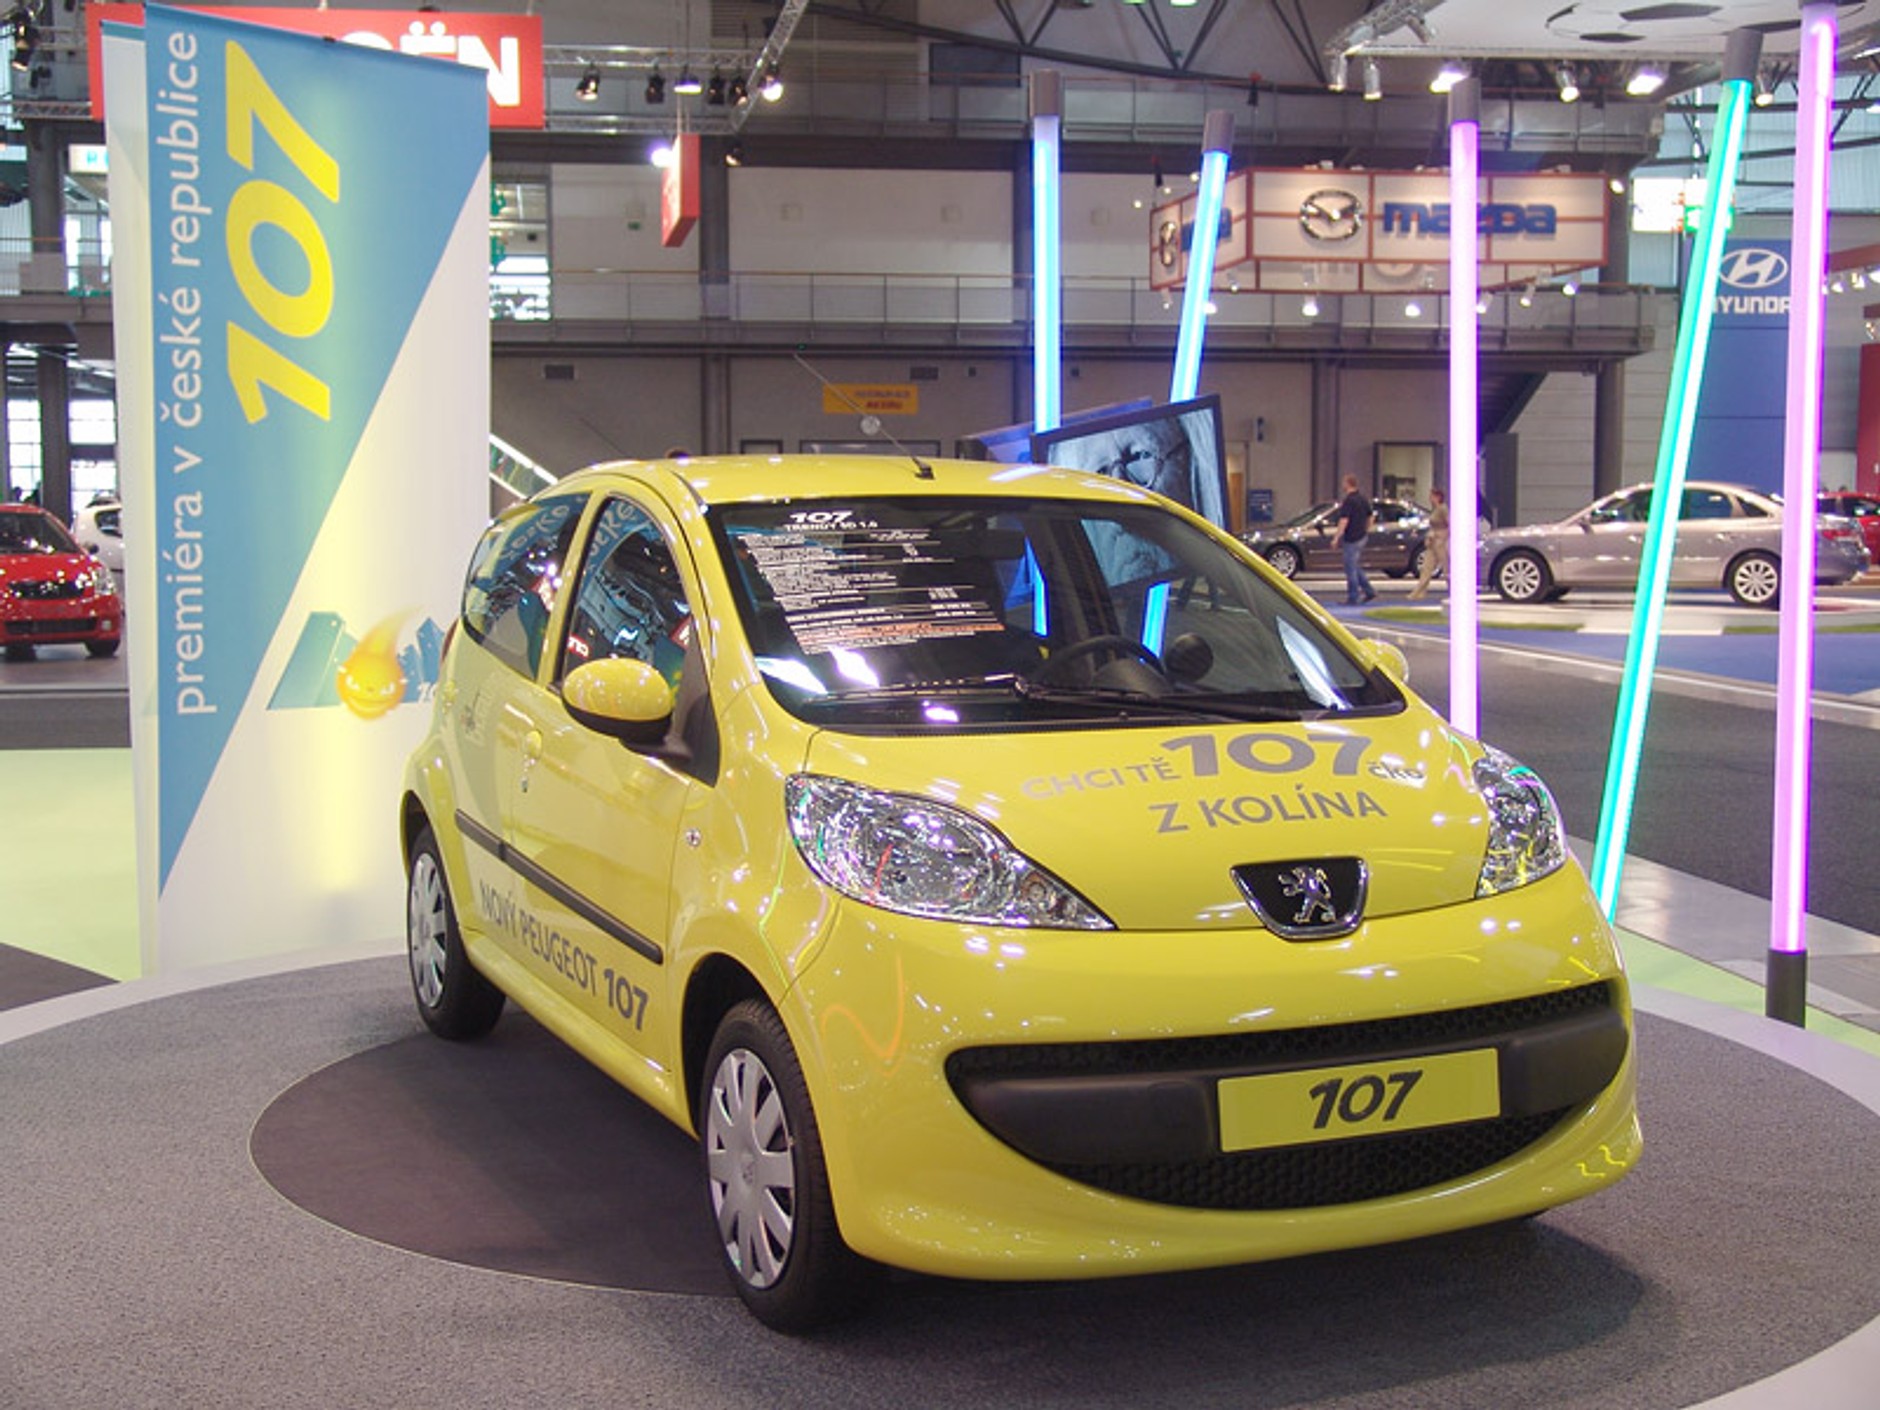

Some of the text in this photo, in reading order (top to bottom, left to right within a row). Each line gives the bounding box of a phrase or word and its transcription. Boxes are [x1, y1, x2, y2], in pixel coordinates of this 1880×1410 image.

[225, 39, 340, 424] 107
[155, 31, 217, 715] premiéra v české republice
[790, 510, 853, 524] 107
[1020, 768, 1125, 799] CHCI
[1125, 757, 1182, 783] TĚ
[1161, 733, 1372, 777] 107
[1148, 784, 1387, 833] Z KOLÍNA
[480, 879, 649, 1031] NOVÝ PEUGEOT 107
[1309, 1069, 1423, 1129] 107
